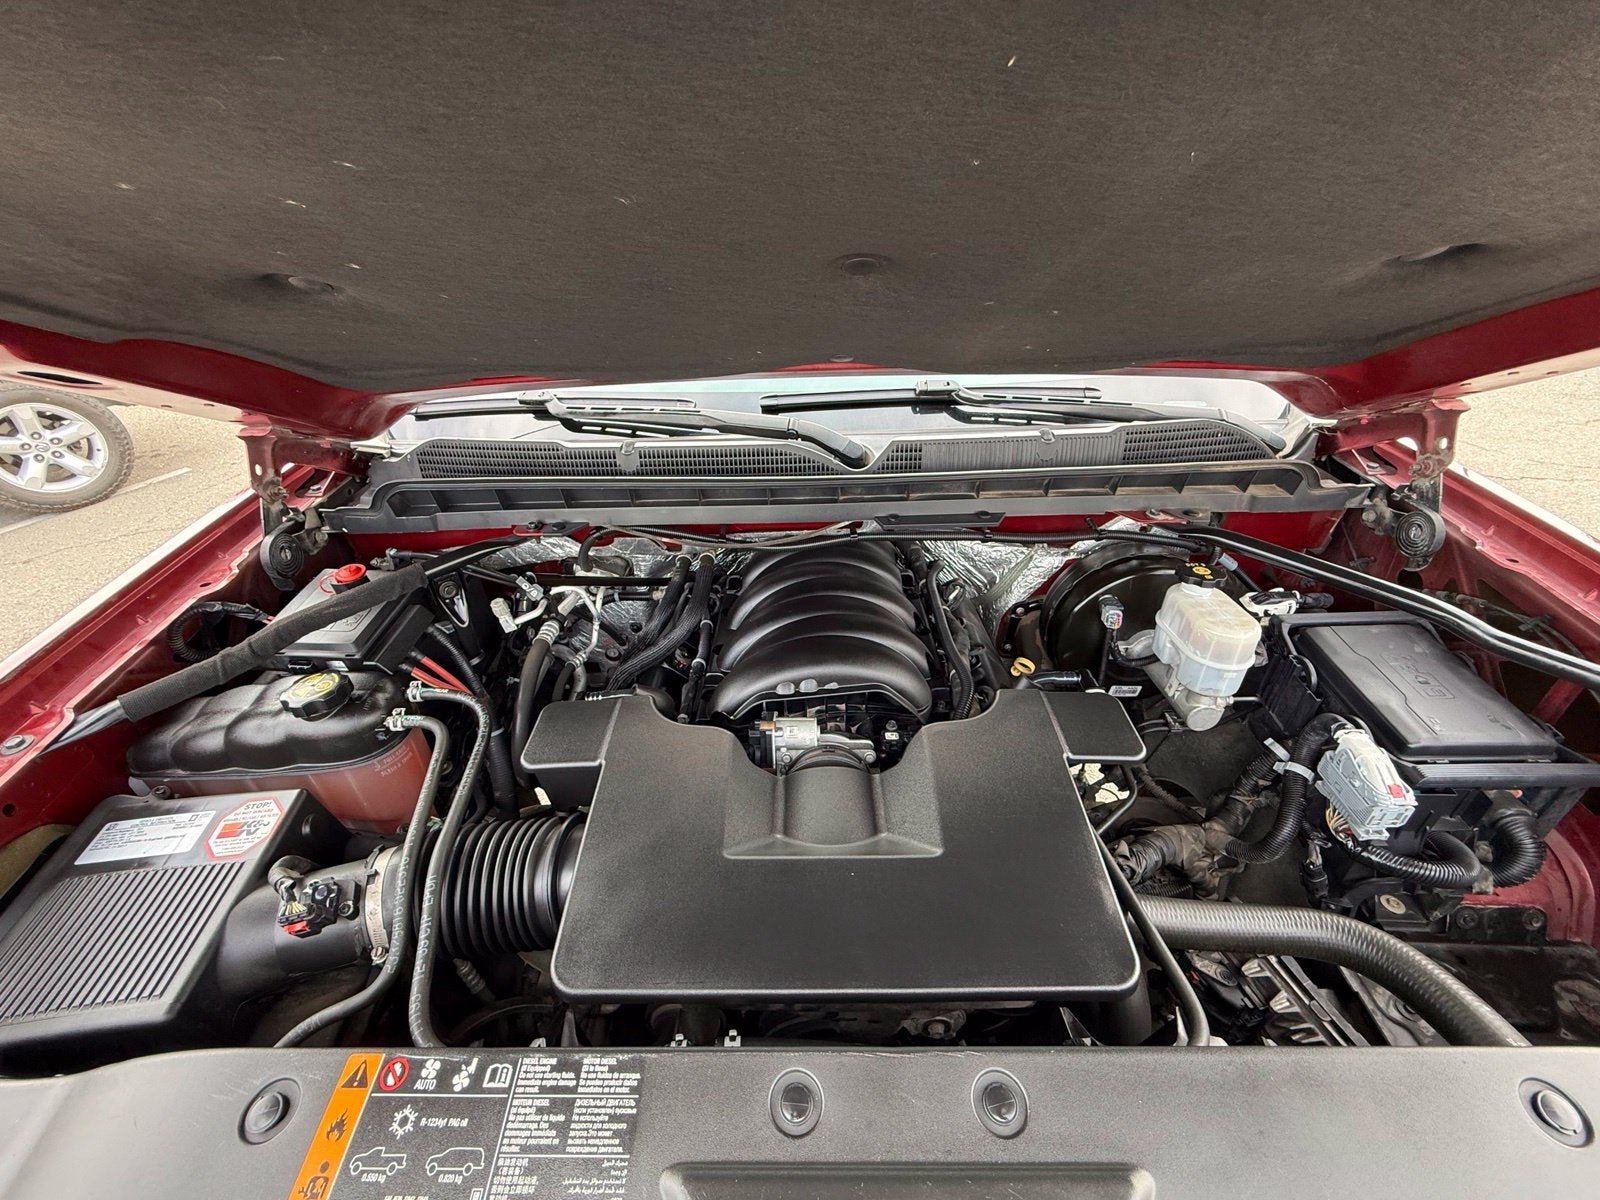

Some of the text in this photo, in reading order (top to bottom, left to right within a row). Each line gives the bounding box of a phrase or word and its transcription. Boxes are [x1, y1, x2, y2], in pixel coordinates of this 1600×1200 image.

[414, 1079, 436, 1091] AUTO
[377, 1173, 386, 1183] kg
[454, 1174, 463, 1184] kg
